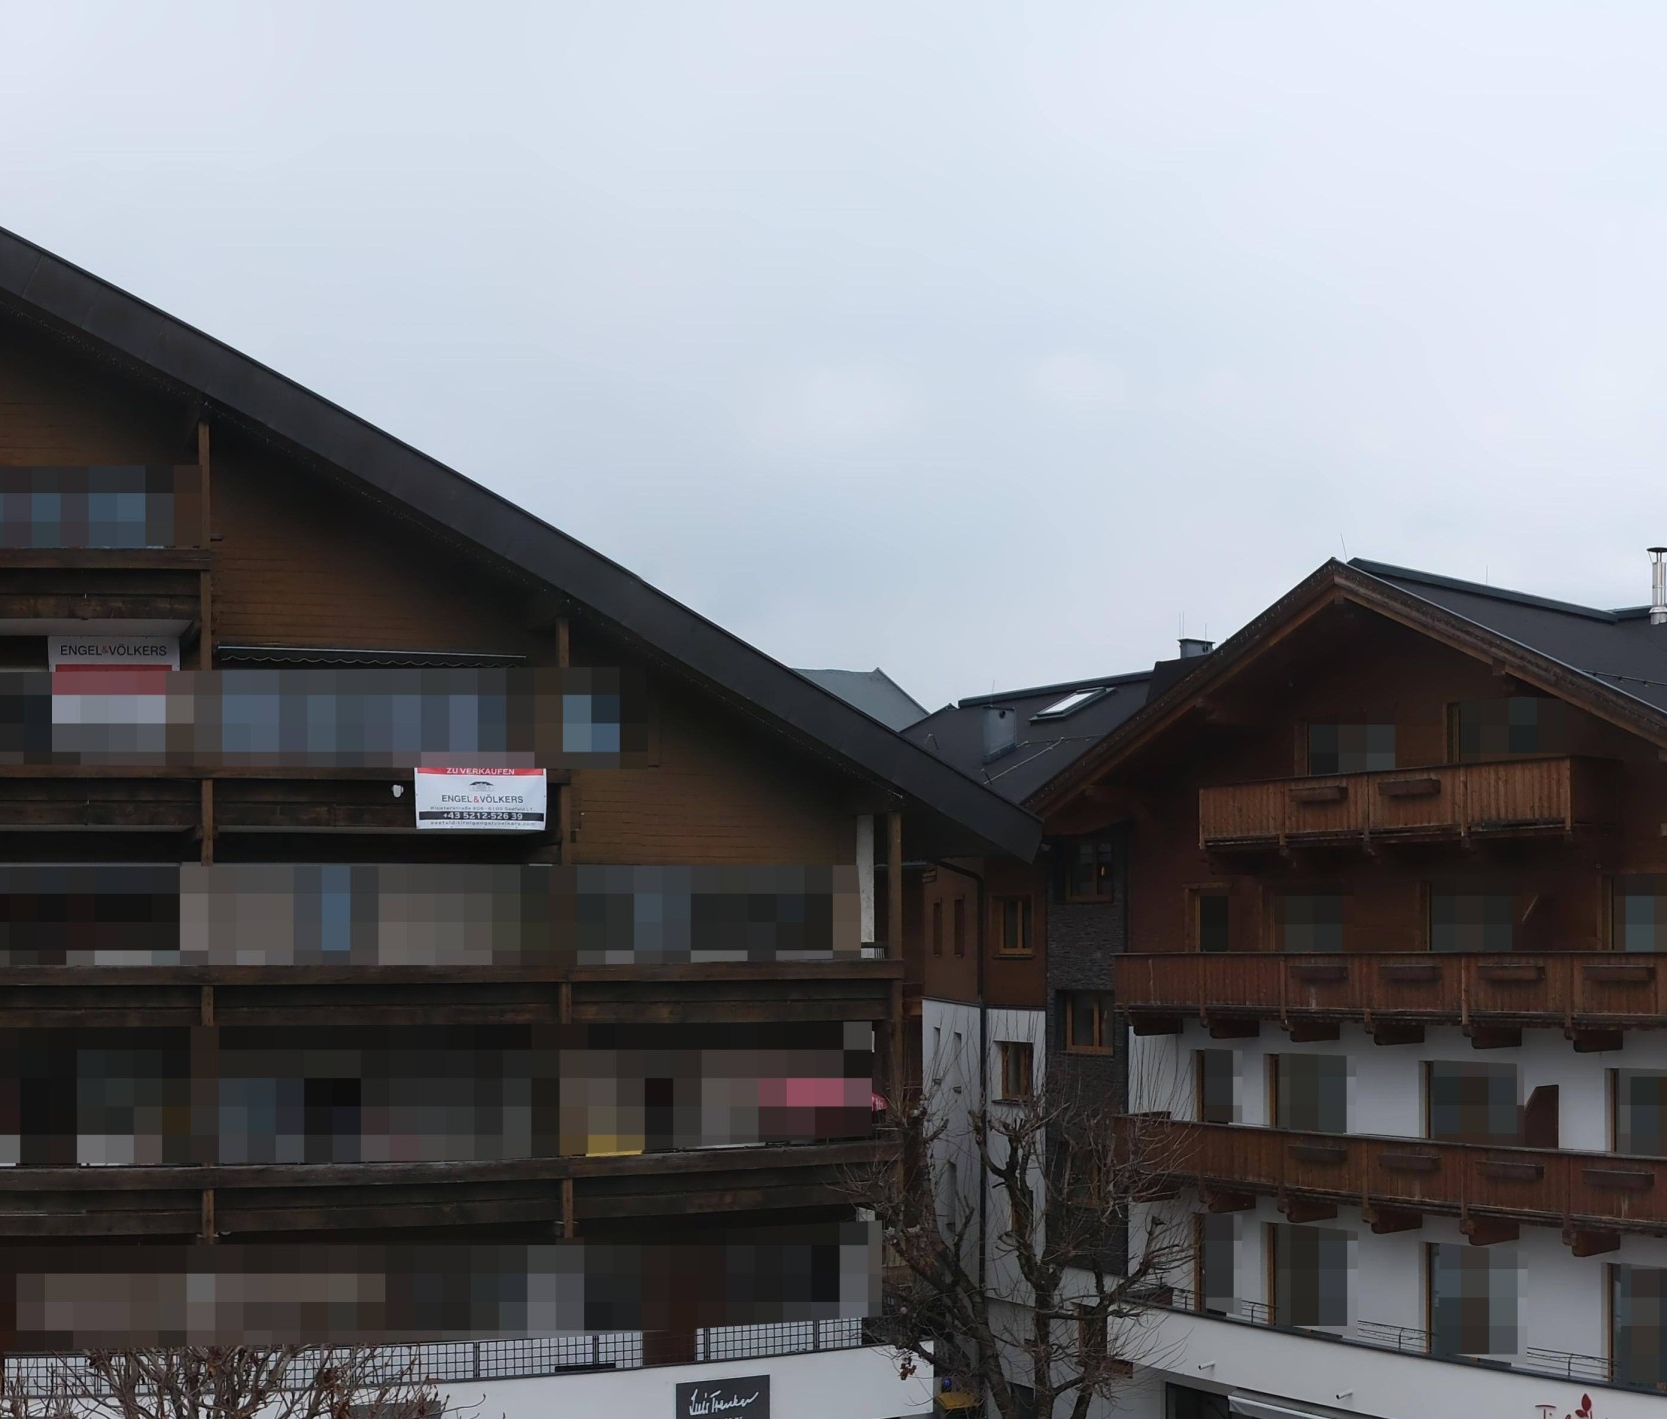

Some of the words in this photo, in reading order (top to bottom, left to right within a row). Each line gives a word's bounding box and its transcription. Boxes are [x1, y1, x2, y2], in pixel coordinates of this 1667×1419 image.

[60, 643, 167, 656] ENGEL&VÖLKERS
[441, 794, 524, 804] ENGEL&VÖLKERS
[463, 812, 509, 820] 5212-526
